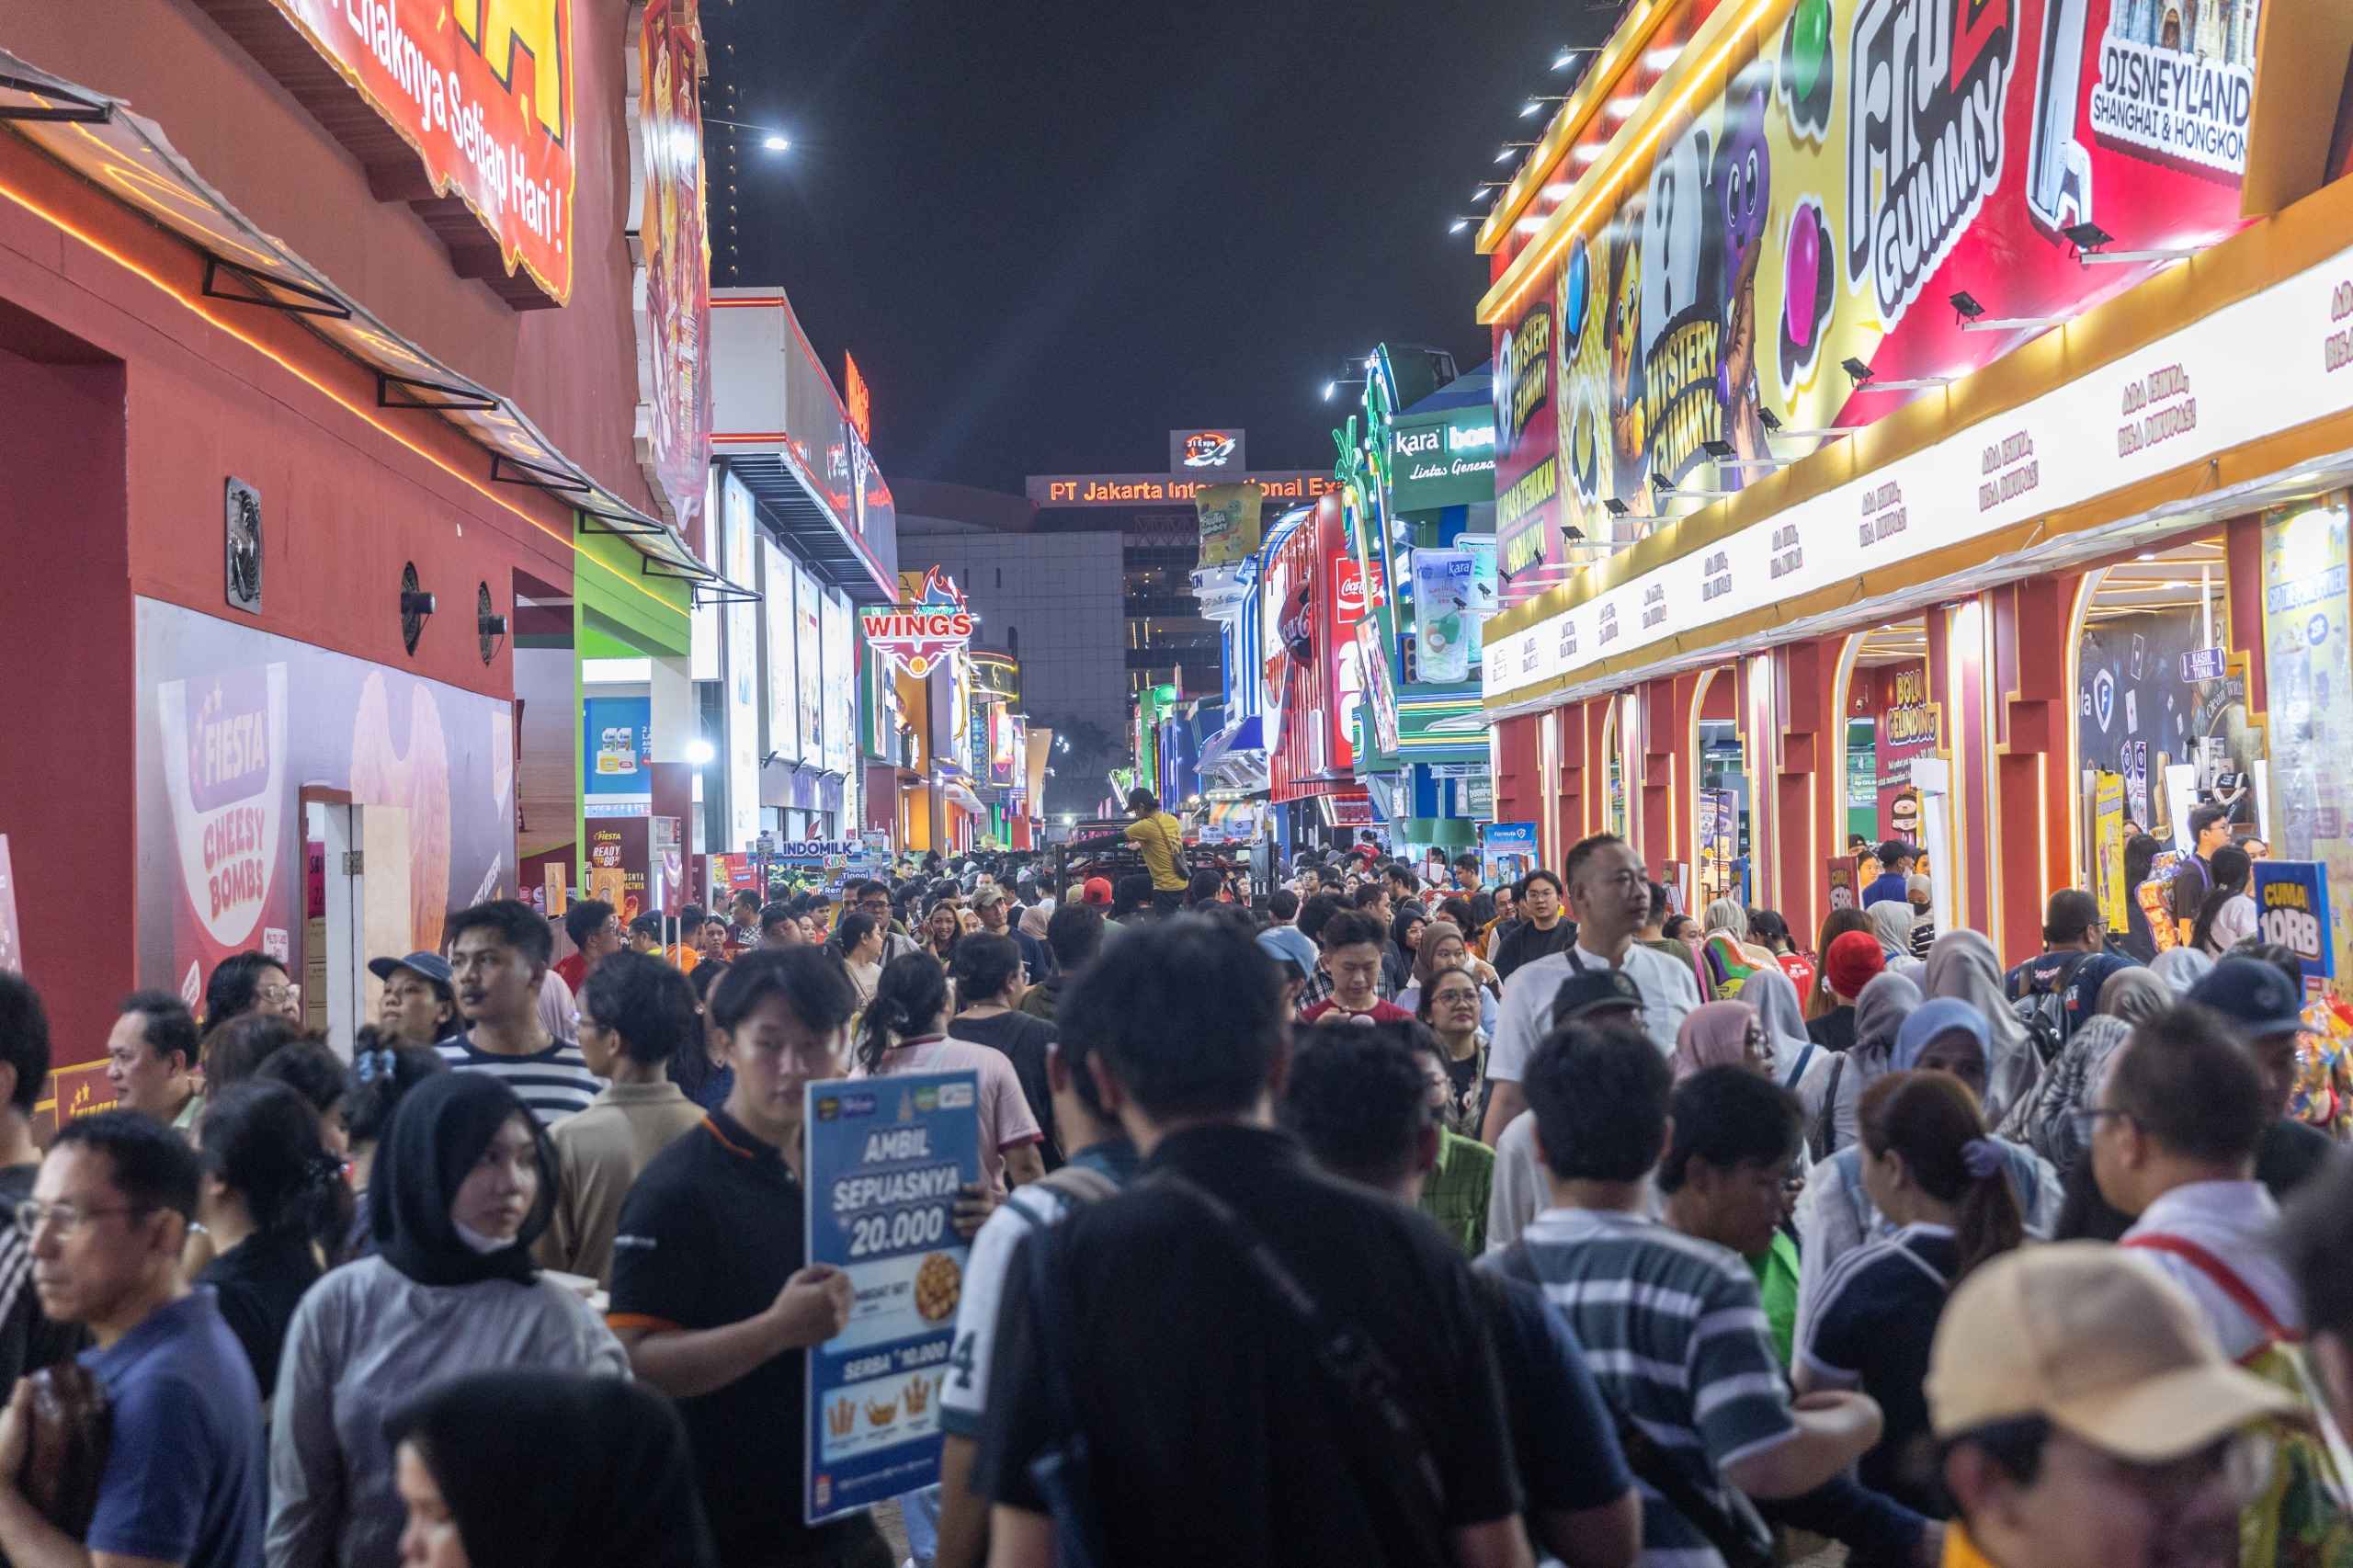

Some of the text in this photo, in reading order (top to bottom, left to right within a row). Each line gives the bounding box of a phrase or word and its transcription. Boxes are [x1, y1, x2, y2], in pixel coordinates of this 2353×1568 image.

[2104, 46, 2250, 127] DISNEYLAND
[2093, 93, 2158, 139] SHANGHAI
[2162, 117, 2172, 142] &
[448, 71, 507, 214] Setiap
[1879, 56, 2000, 307] GUMMY
[1513, 313, 1551, 378] MYSTERY
[1645, 320, 1720, 439] MYSTERY
[2121, 379, 2147, 415] ADA
[1396, 429, 1440, 456] kara
[1410, 460, 1448, 480] Lintas
[1051, 483, 1077, 501] PT
[1084, 482, 1163, 501] Jakarta
[1168, 478, 1302, 500] Intonal
[1449, 562, 1471, 577] kara
[864, 614, 972, 638] WINGS
[1895, 671, 1924, 706] BOLA
[204, 710, 267, 787] FIESTA
[203, 807, 266, 873] CHEESY
[593, 846, 621, 857] READY
[597, 832, 621, 840] FIESTA
[783, 842, 853, 856] INDOMILK
[824, 855, 847, 869] KIDS
[210, 858, 265, 923] BOMBS
[2264, 882, 2307, 907] CUMA
[2260, 907, 2320, 956] 10RB
[863, 1128, 931, 1163] AMBIL
[833, 1165, 960, 1212] SEPUASNYA
[849, 1205, 945, 1256] 20.000
